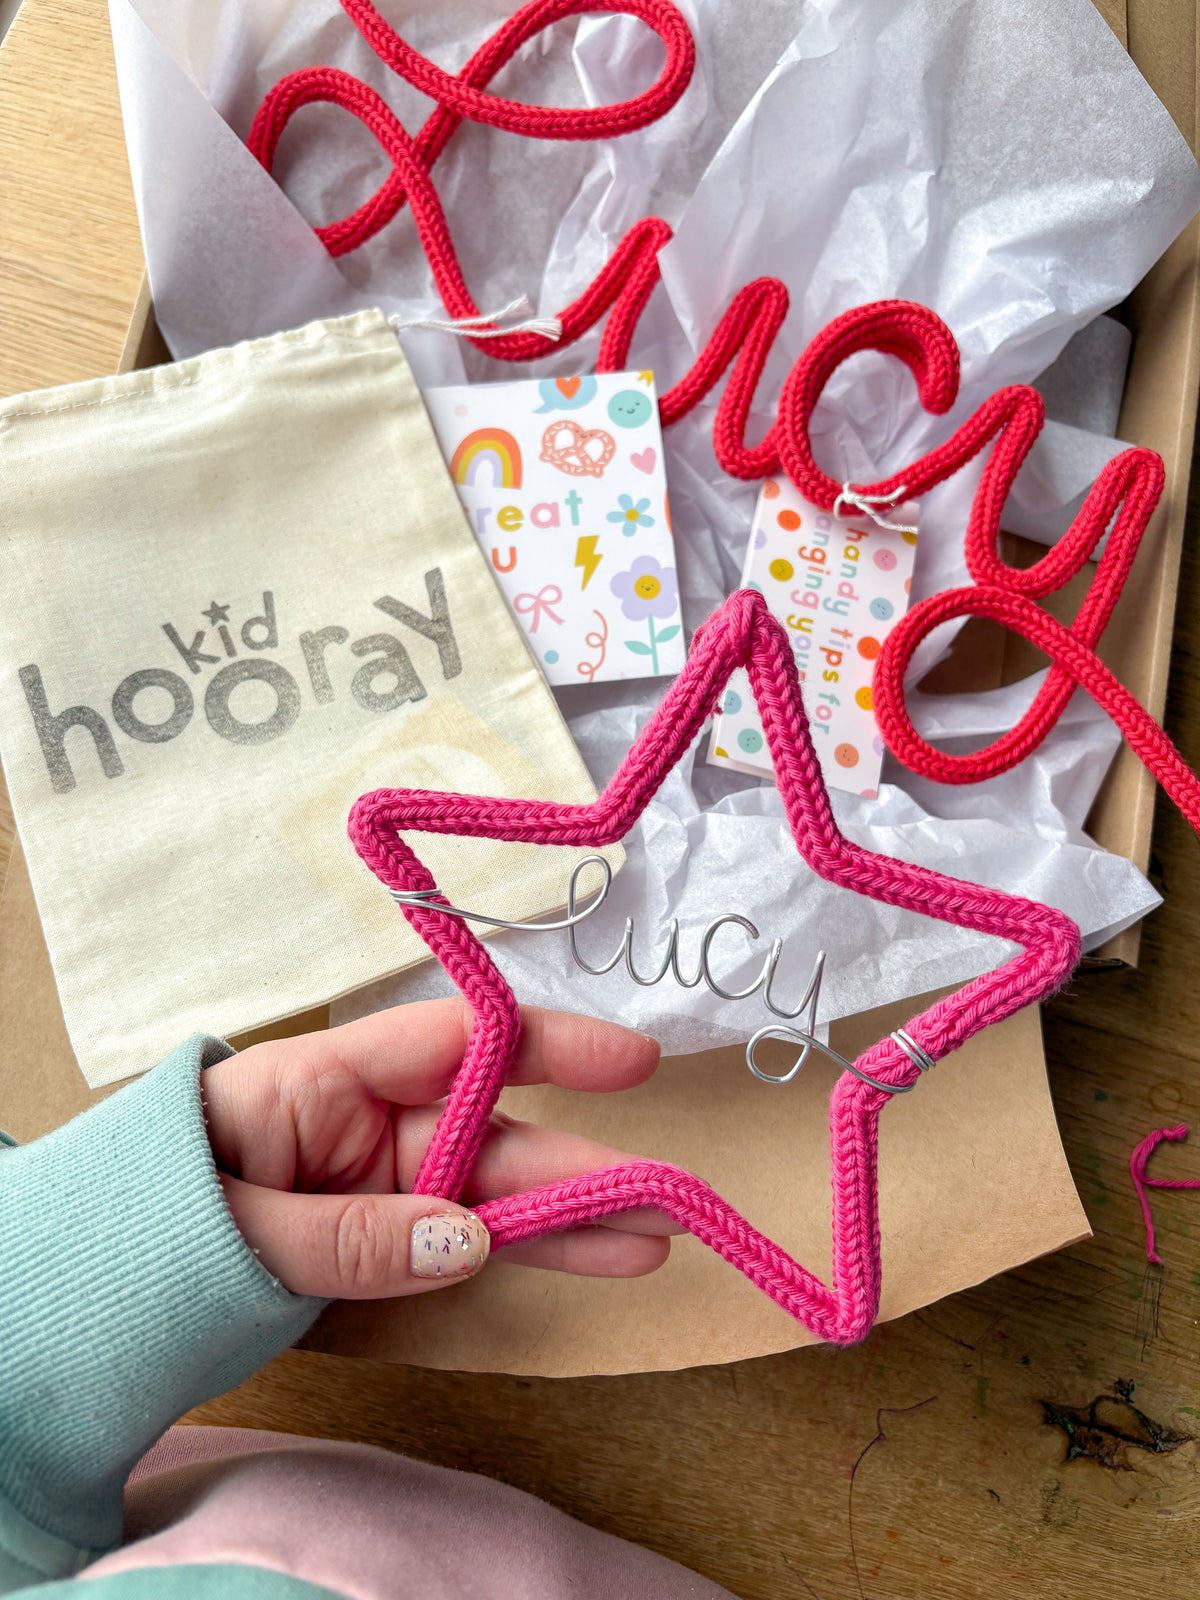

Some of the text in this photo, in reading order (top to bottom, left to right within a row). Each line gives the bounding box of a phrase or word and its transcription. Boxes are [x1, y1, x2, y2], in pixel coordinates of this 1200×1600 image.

[464, 489, 583, 534] reat
[790, 510, 832, 610] anging
[18, 567, 463, 795] hooray
[162, 590, 279, 675] kid
[814, 527, 868, 735] handy tips for
[566, 854, 827, 1084] lucy
